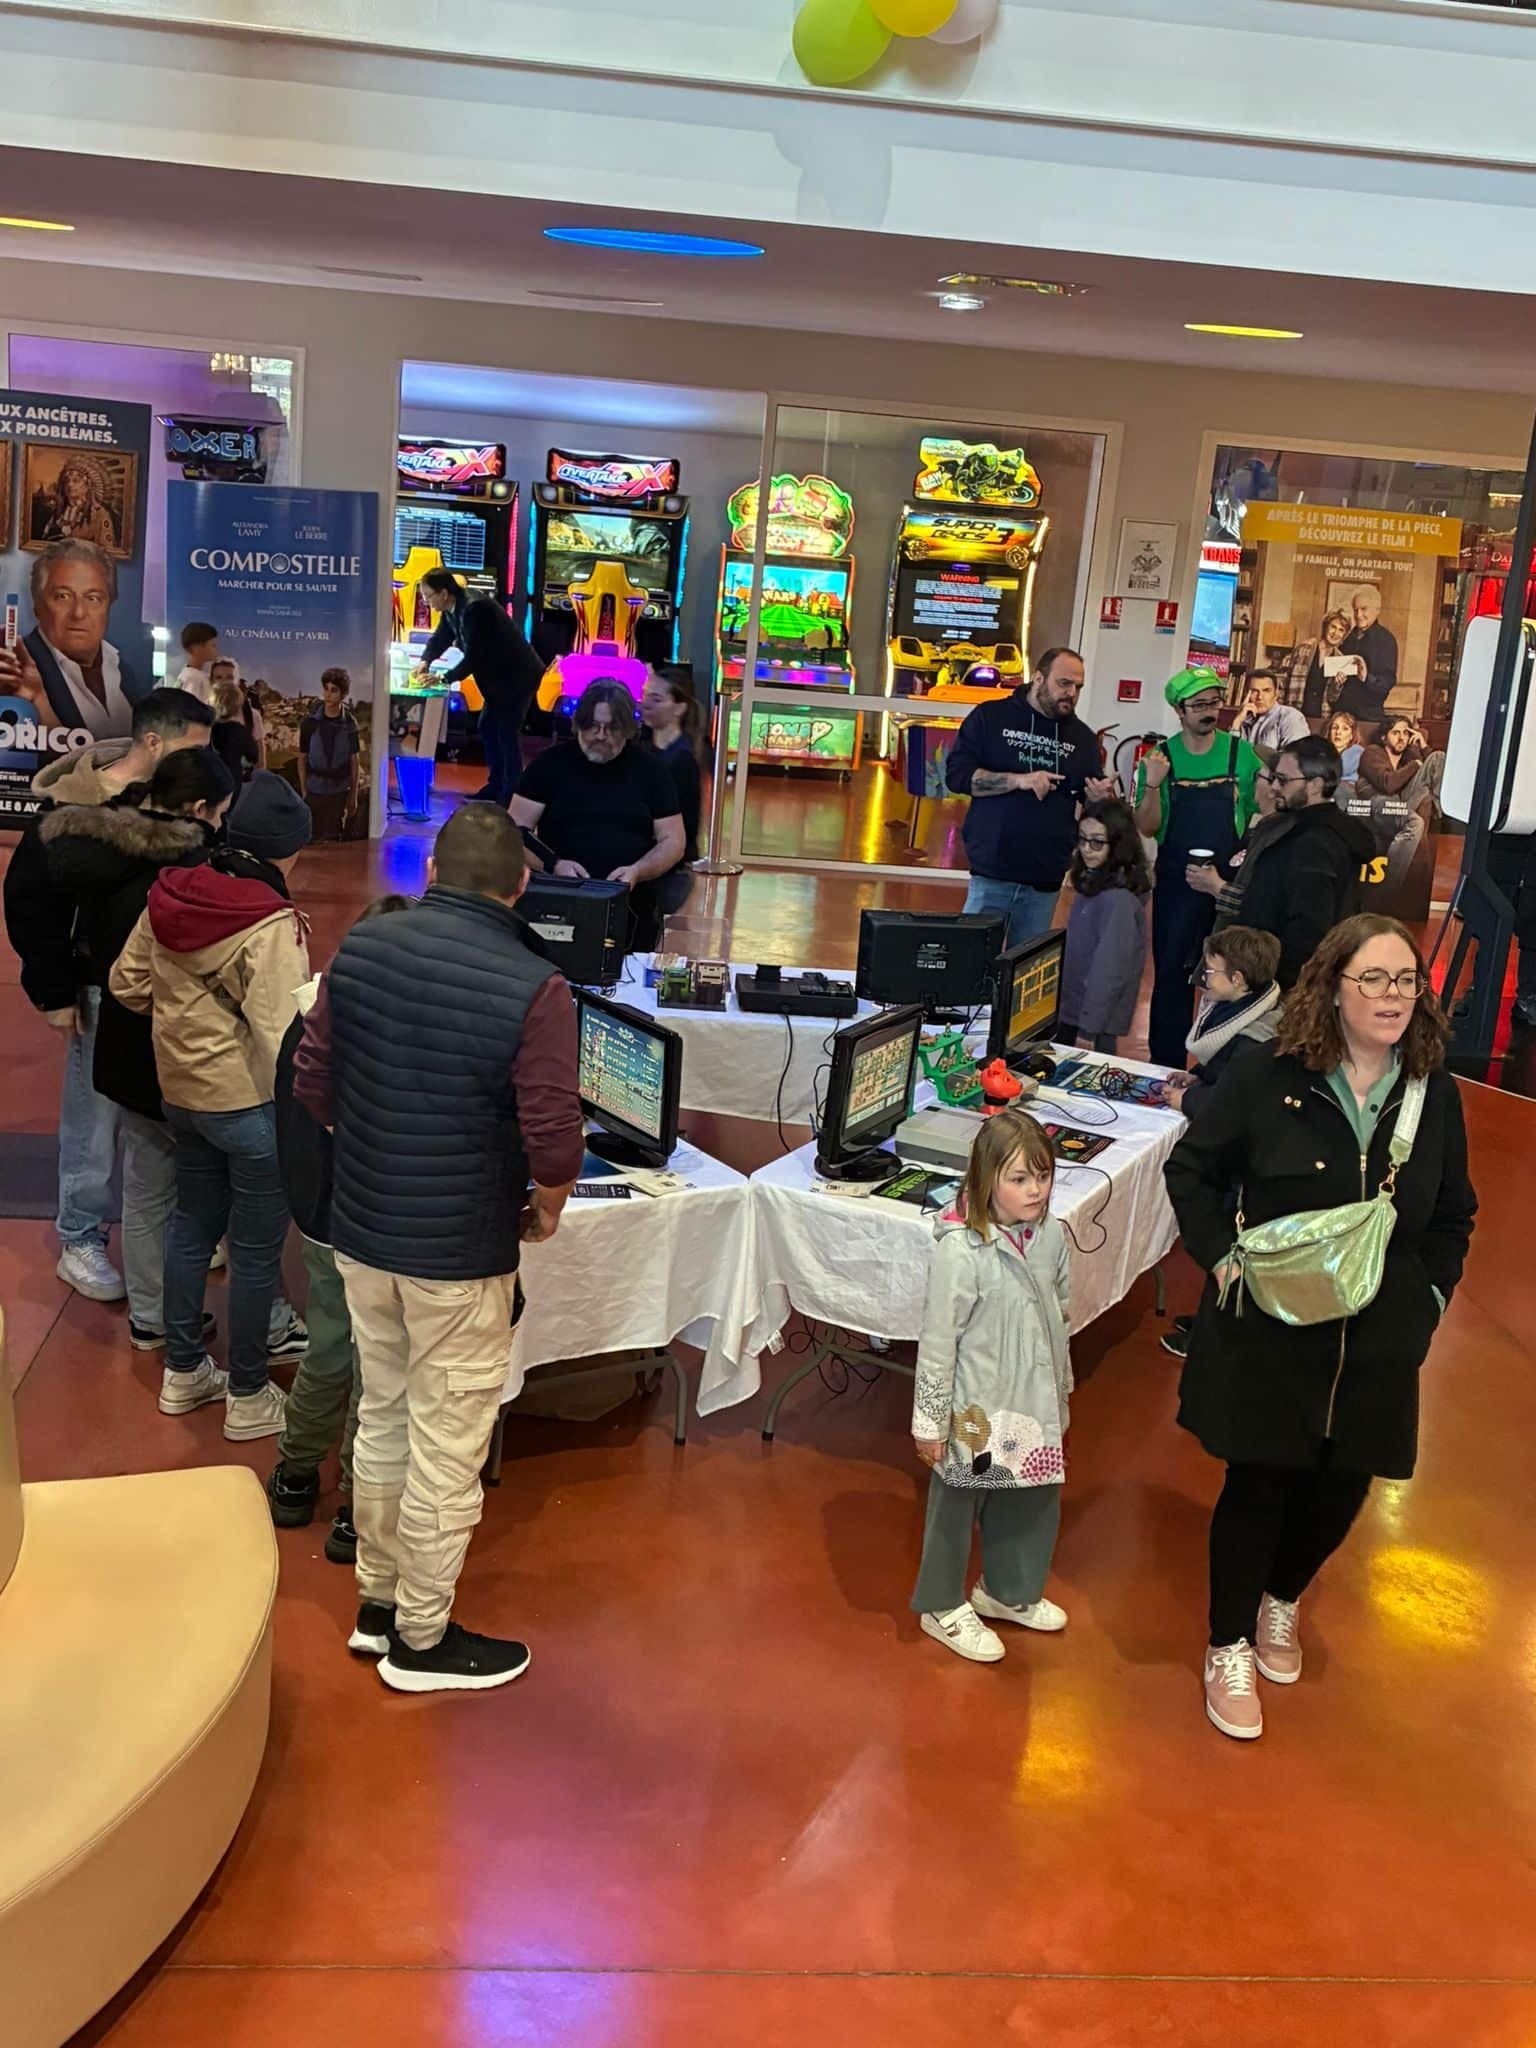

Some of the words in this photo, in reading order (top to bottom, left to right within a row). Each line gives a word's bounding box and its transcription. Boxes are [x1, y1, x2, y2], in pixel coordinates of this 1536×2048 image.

[25, 406, 113, 427] ANCÊTRES.
[15, 422, 118, 444] PROBLÈMES.
[932, 518, 997, 532] SUPER
[1267, 508, 1304, 522] APRÈS
[1307, 513, 1320, 525] LE
[1322, 514, 1379, 530] TRIOMPHE
[1382, 519, 1395, 531] DE
[1398, 520, 1411, 533] LA
[1299, 525, 1364, 544] DÉCOUVREZ
[1367, 532, 1379, 545] LE
[1381, 534, 1406, 547] FILM
[189, 547, 362, 577] COMPOSTELLE
[1202, 546, 1241, 564] TRANS
[1306, 555, 1341, 568] FAMILLE,
[1356, 558, 1393, 571] PARTAGE
[218, 578, 265, 591] MARCHER
[266, 580, 292, 592] POUR
[306, 583, 338, 593] SAUVER
[223, 627, 239, 638] AU
[241, 626, 280, 641] CINÉMA
[281, 630, 293, 641] LE
[306, 631, 330, 641] AVRIL
